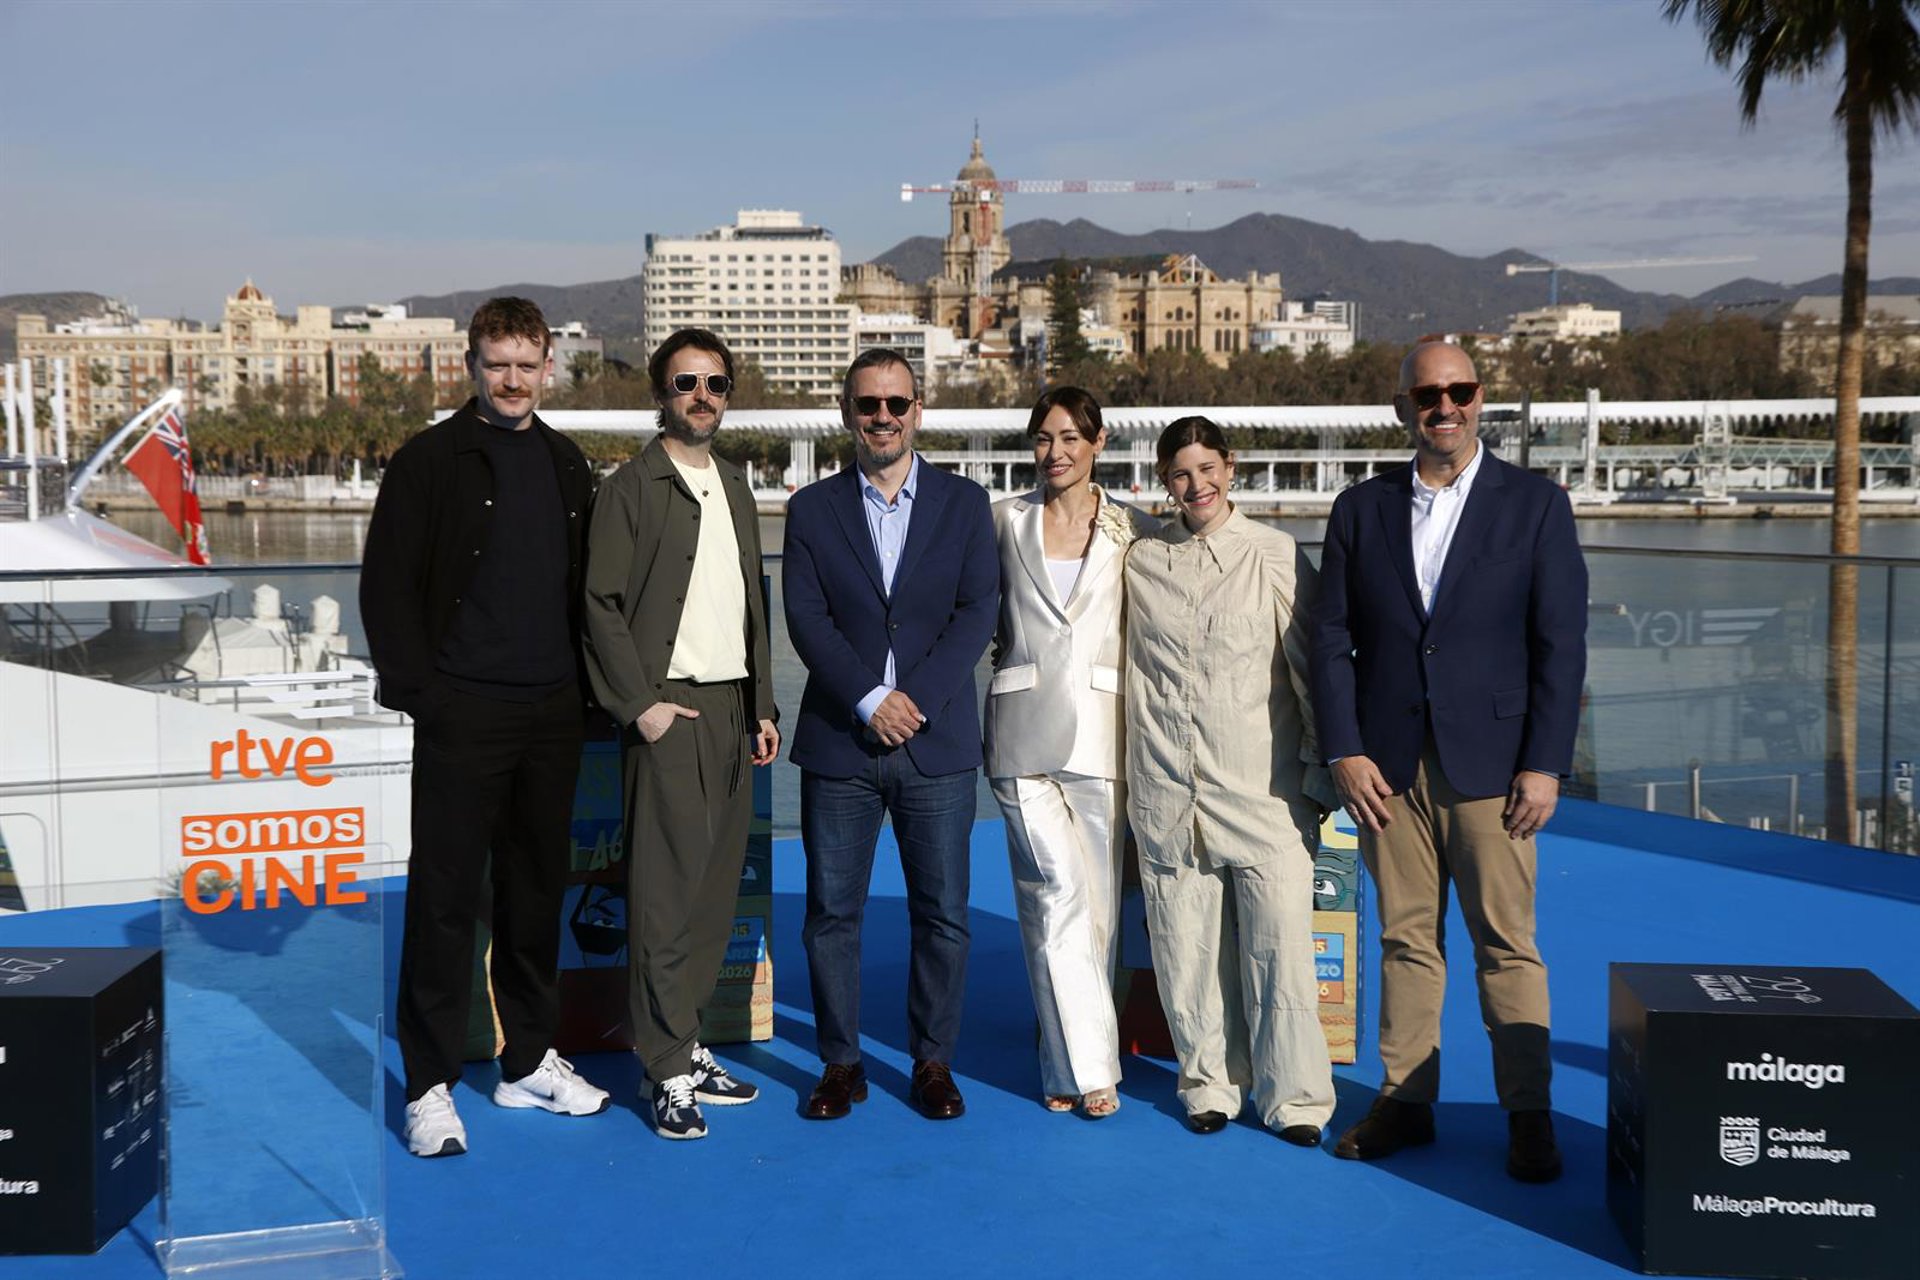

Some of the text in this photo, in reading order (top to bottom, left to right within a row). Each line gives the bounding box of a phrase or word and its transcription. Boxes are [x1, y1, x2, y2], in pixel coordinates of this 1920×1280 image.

[210, 729, 334, 787] rtve
[184, 812, 361, 851] somos
[181, 852, 367, 914] CINE
[1767, 1127, 1826, 1142] Ciudad
[1767, 1144, 1850, 1163] de Málaga
[1693, 1194, 1876, 1218] MálagaProcultura
